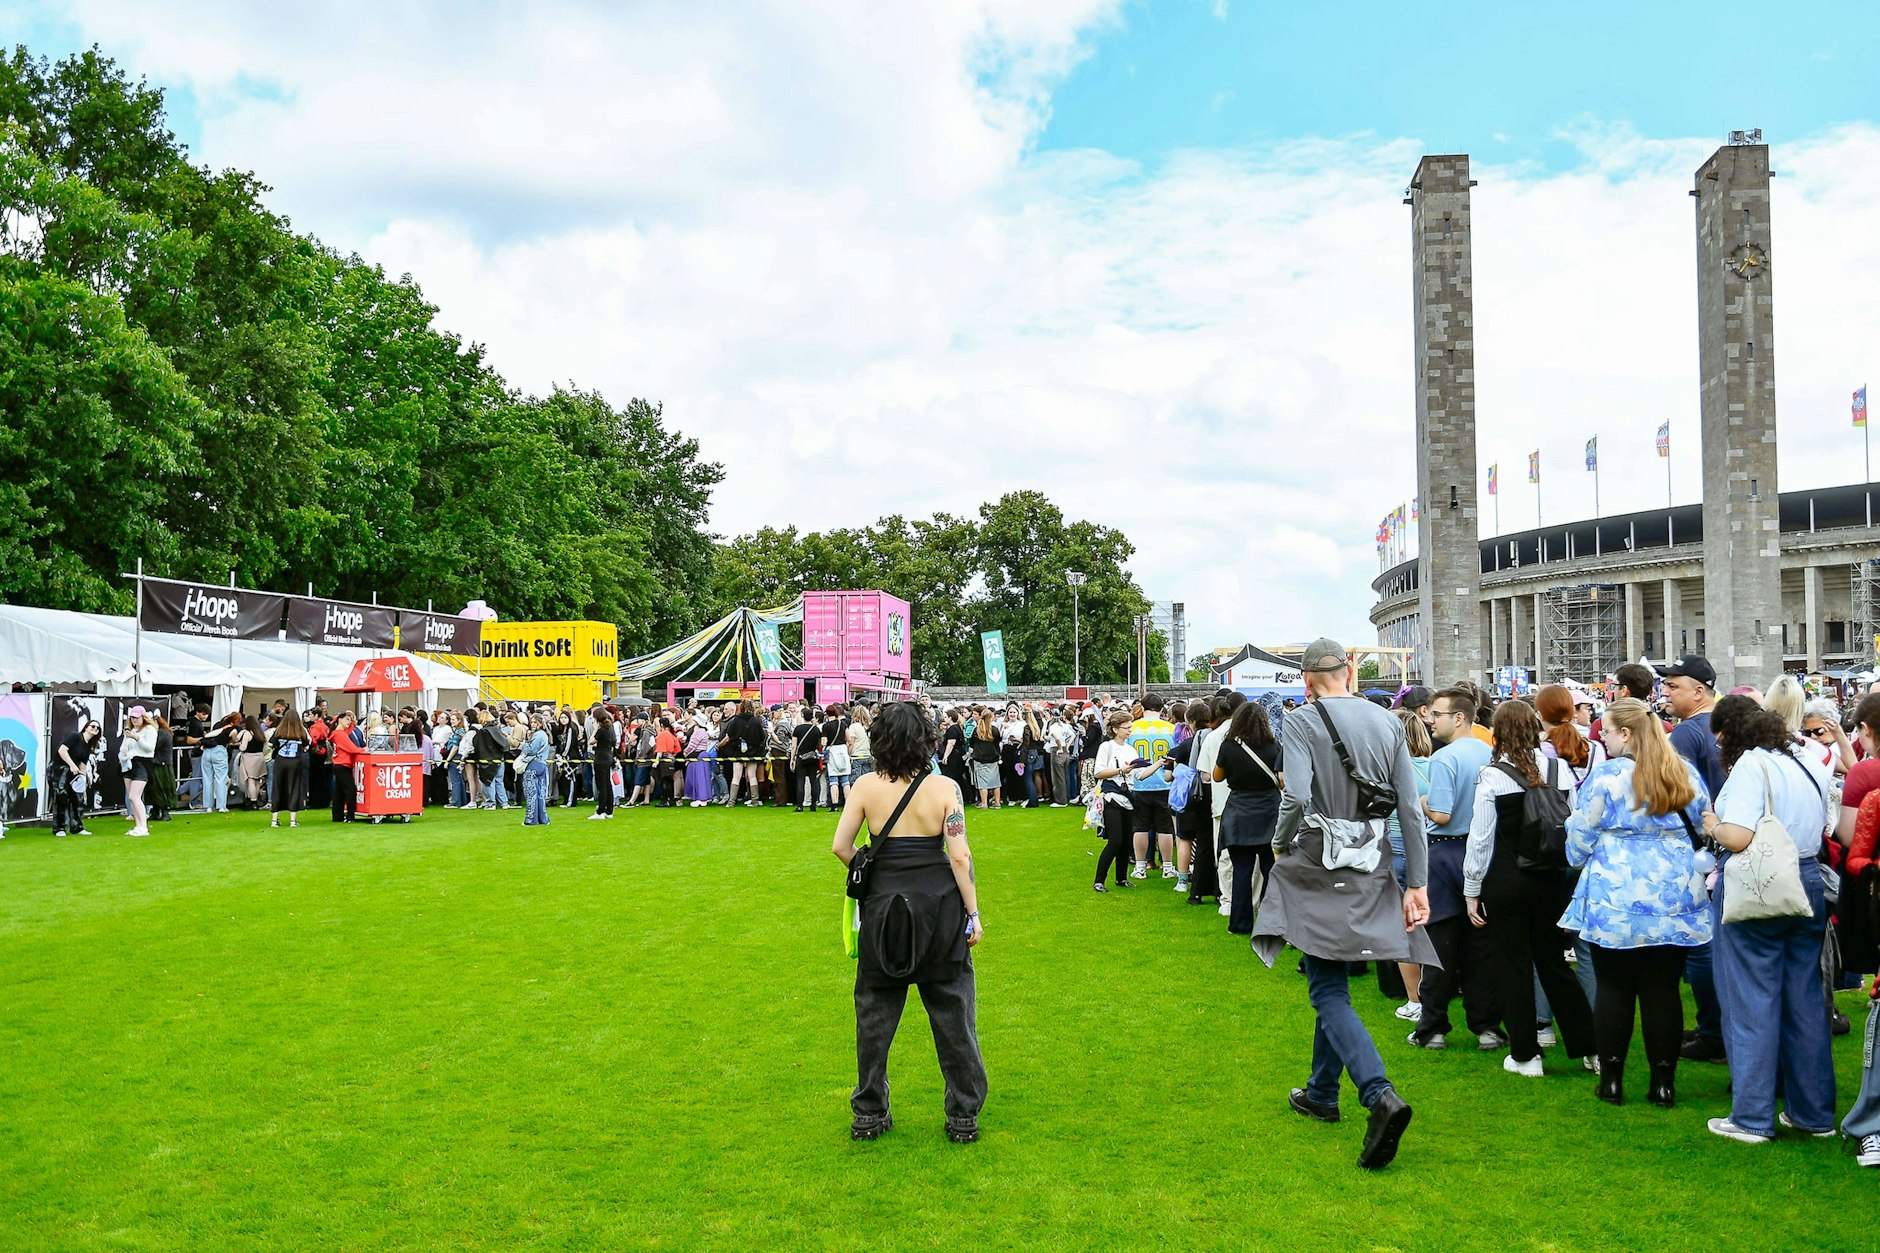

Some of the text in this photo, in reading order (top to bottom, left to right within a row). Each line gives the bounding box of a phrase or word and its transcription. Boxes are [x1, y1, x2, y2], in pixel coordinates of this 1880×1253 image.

[181, 587, 238, 625] j-hope
[323, 604, 363, 635] j-hope
[424, 616, 455, 643] j-hope
[482, 639, 529, 658] Drink
[534, 638, 572, 657] Soft
[391, 664, 410, 681] ICE
[1275, 671, 1301, 684] Korea
[391, 680, 411, 688] CREAM
[1134, 739, 1169, 765] 08
[385, 765, 412, 789] ICE
[385, 789, 412, 799] CREAM
